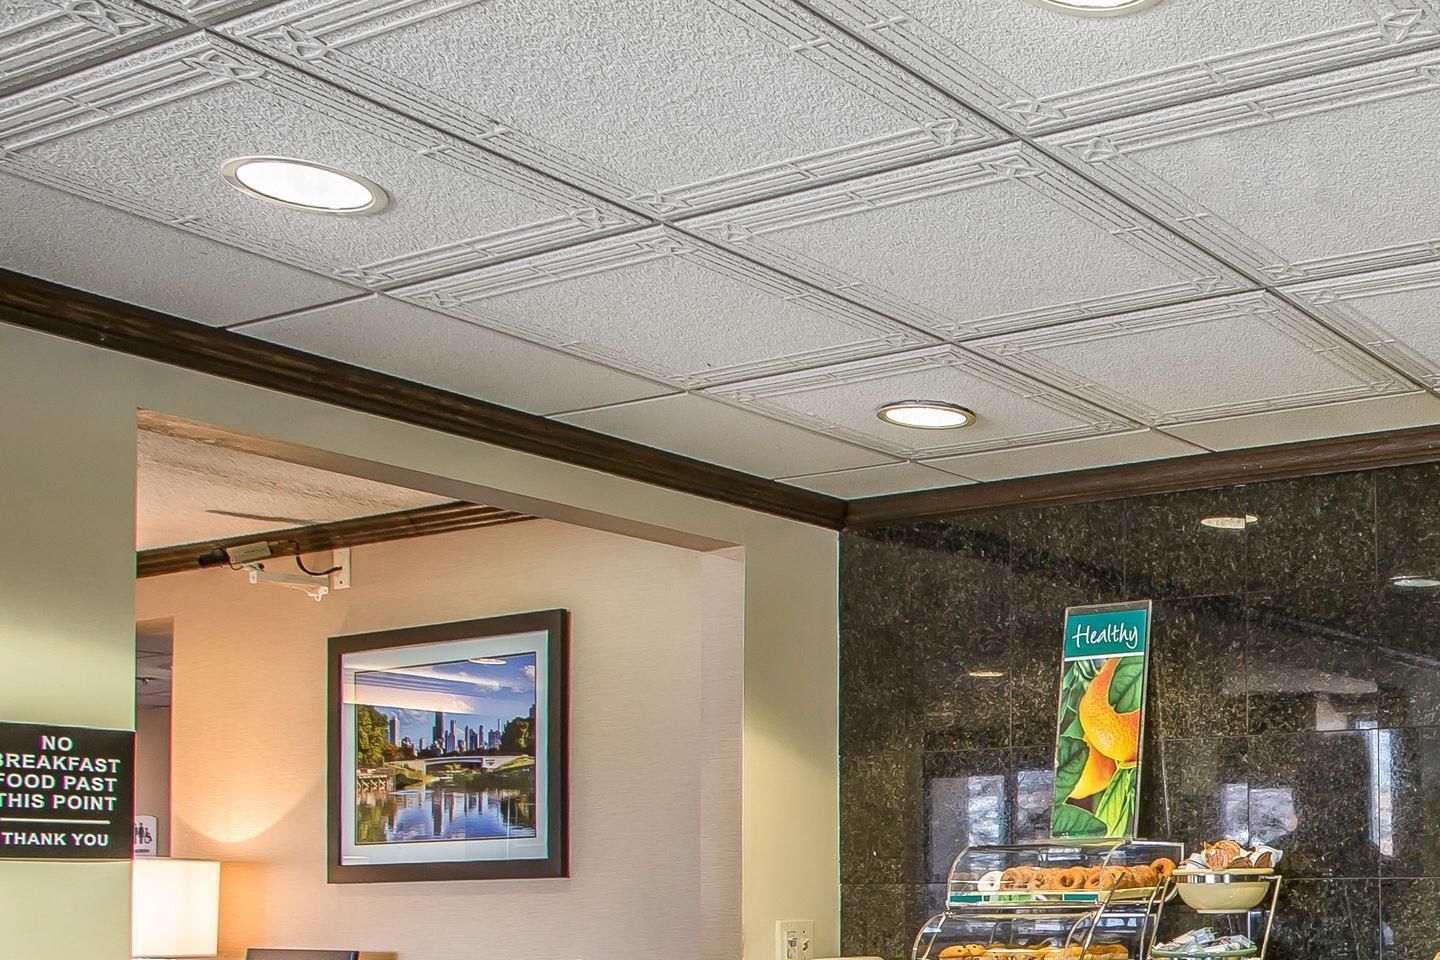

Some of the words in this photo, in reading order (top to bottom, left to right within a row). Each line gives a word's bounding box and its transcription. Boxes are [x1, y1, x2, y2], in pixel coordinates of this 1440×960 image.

[1072, 622, 1138, 649] Healthy
[41, 735, 73, 751] NO
[0, 752, 120, 773] REAKFAST
[63, 776, 118, 792] PAST
[0, 793, 45, 809] THIS
[53, 795, 117, 811] POINT
[2, 832, 66, 845] THANK
[71, 834, 109, 846] YOU
